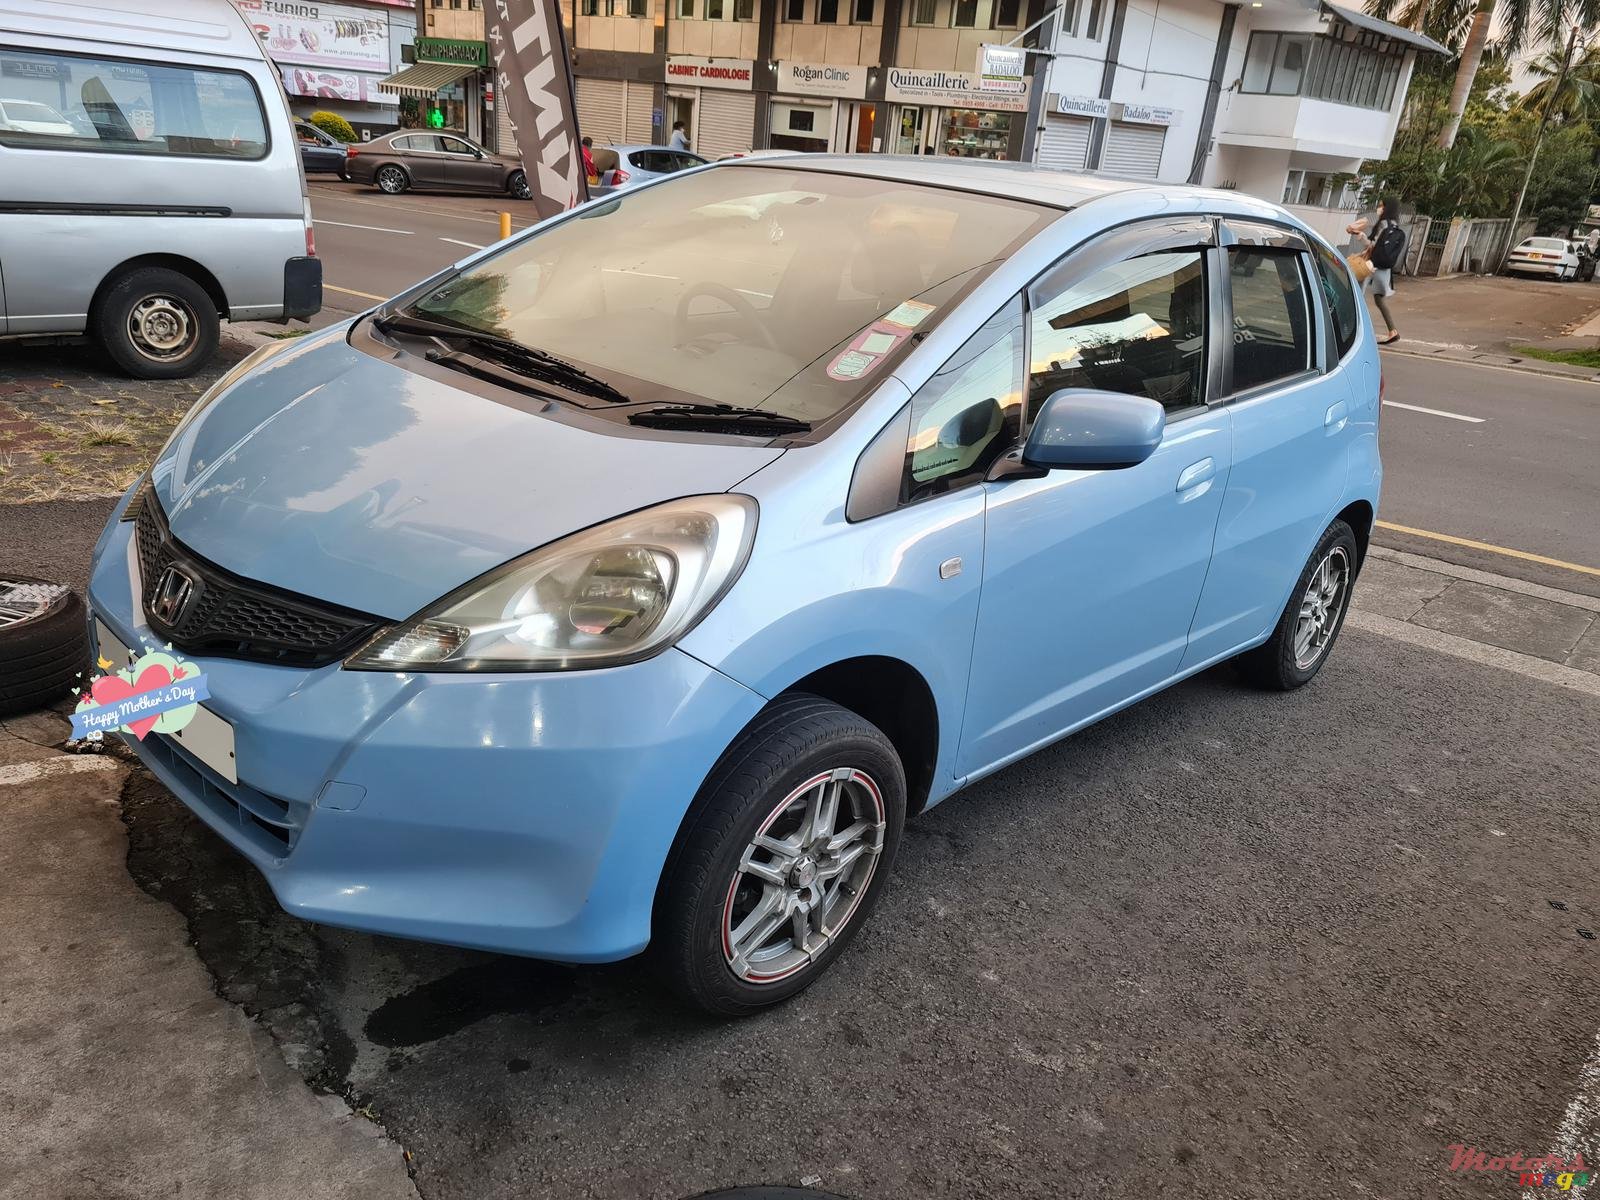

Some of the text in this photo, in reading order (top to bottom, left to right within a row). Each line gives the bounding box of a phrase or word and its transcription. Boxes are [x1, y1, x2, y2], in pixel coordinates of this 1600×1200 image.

[439, 44, 480, 61] PHARMACY
[668, 64, 750, 81] CABINET CARDIOLOGIE
[793, 65, 850, 82] Rogan Clinic
[890, 70, 969, 90] Quincaillerie
[1060, 95, 1107, 115] Quincaillerie
[1123, 106, 1151, 121] Badaloo
